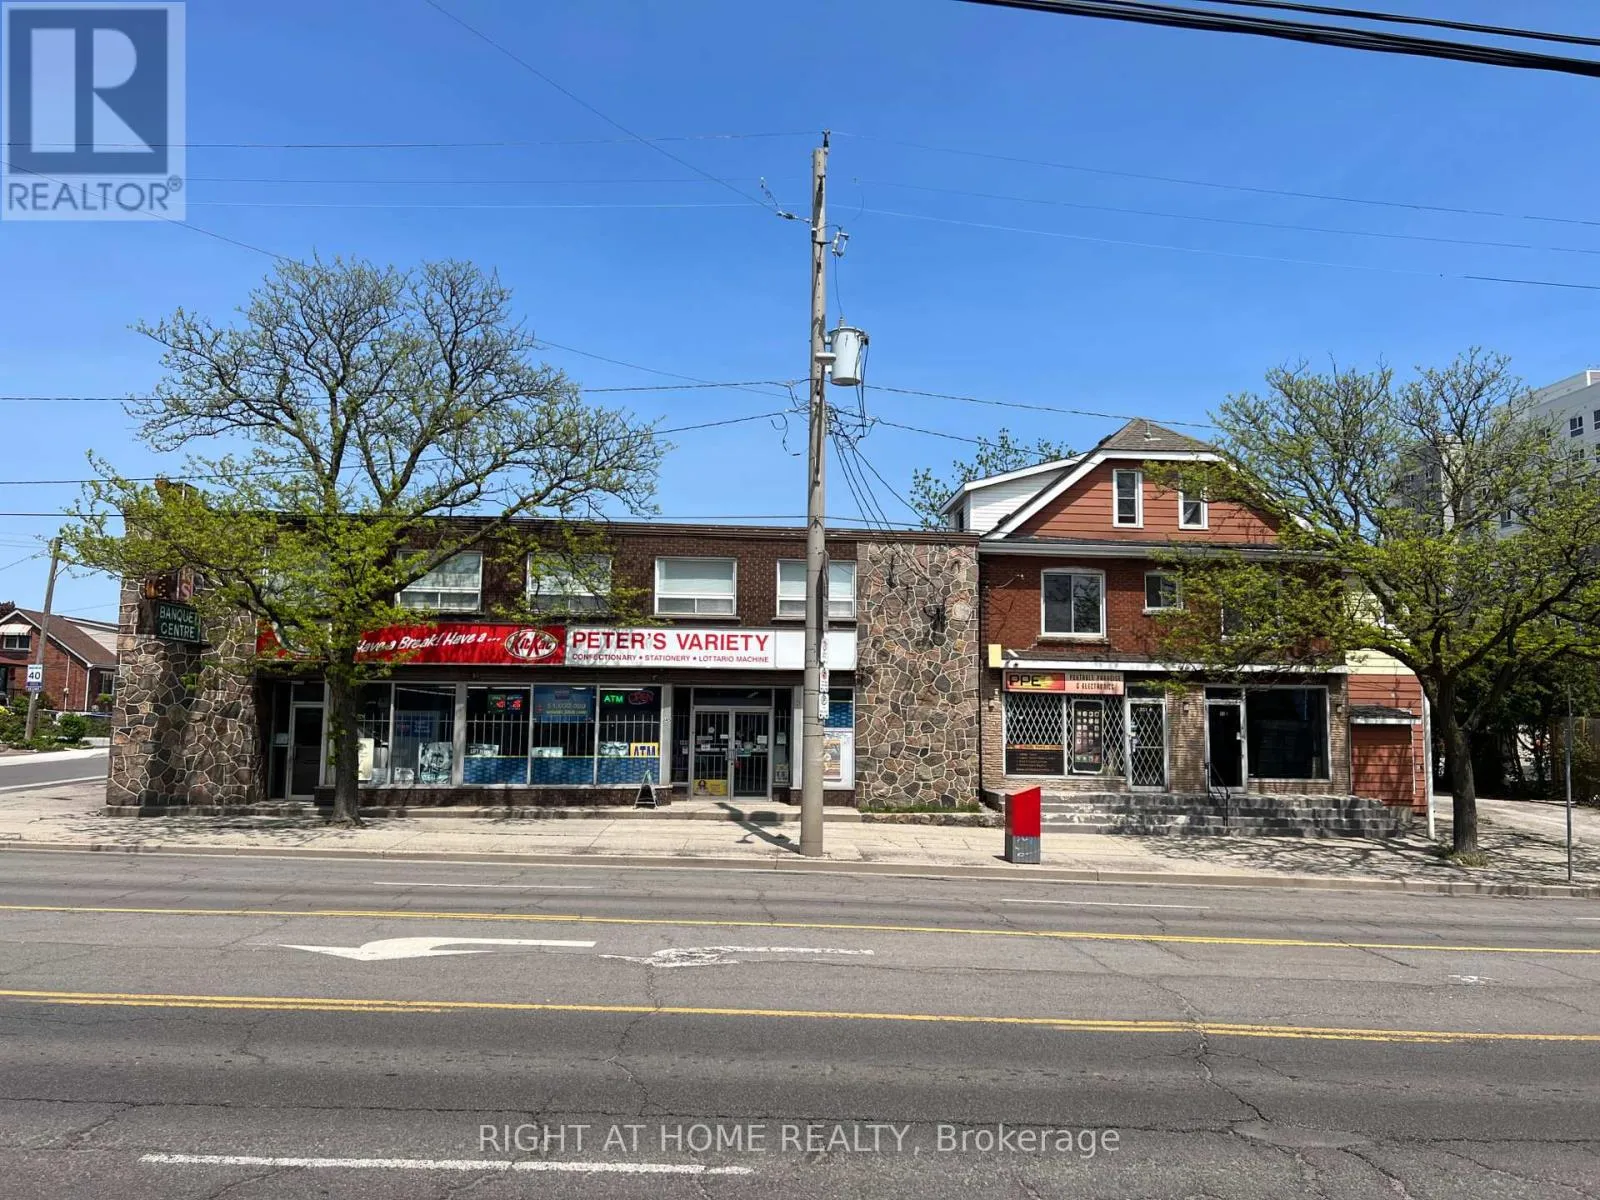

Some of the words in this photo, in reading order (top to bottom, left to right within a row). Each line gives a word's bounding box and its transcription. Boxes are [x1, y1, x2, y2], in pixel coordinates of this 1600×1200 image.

[160, 622, 195, 639] CENTRE
[397, 632, 445, 650] Break!
[442, 631, 477, 646] Have
[572, 632, 667, 650] PETER'S
[676, 633, 769, 651] VARIETY
[28, 671, 41, 680] 40
[1009, 674, 1042, 687] PPE
[603, 694, 624, 703] ATM
[633, 745, 656, 757] ATM
